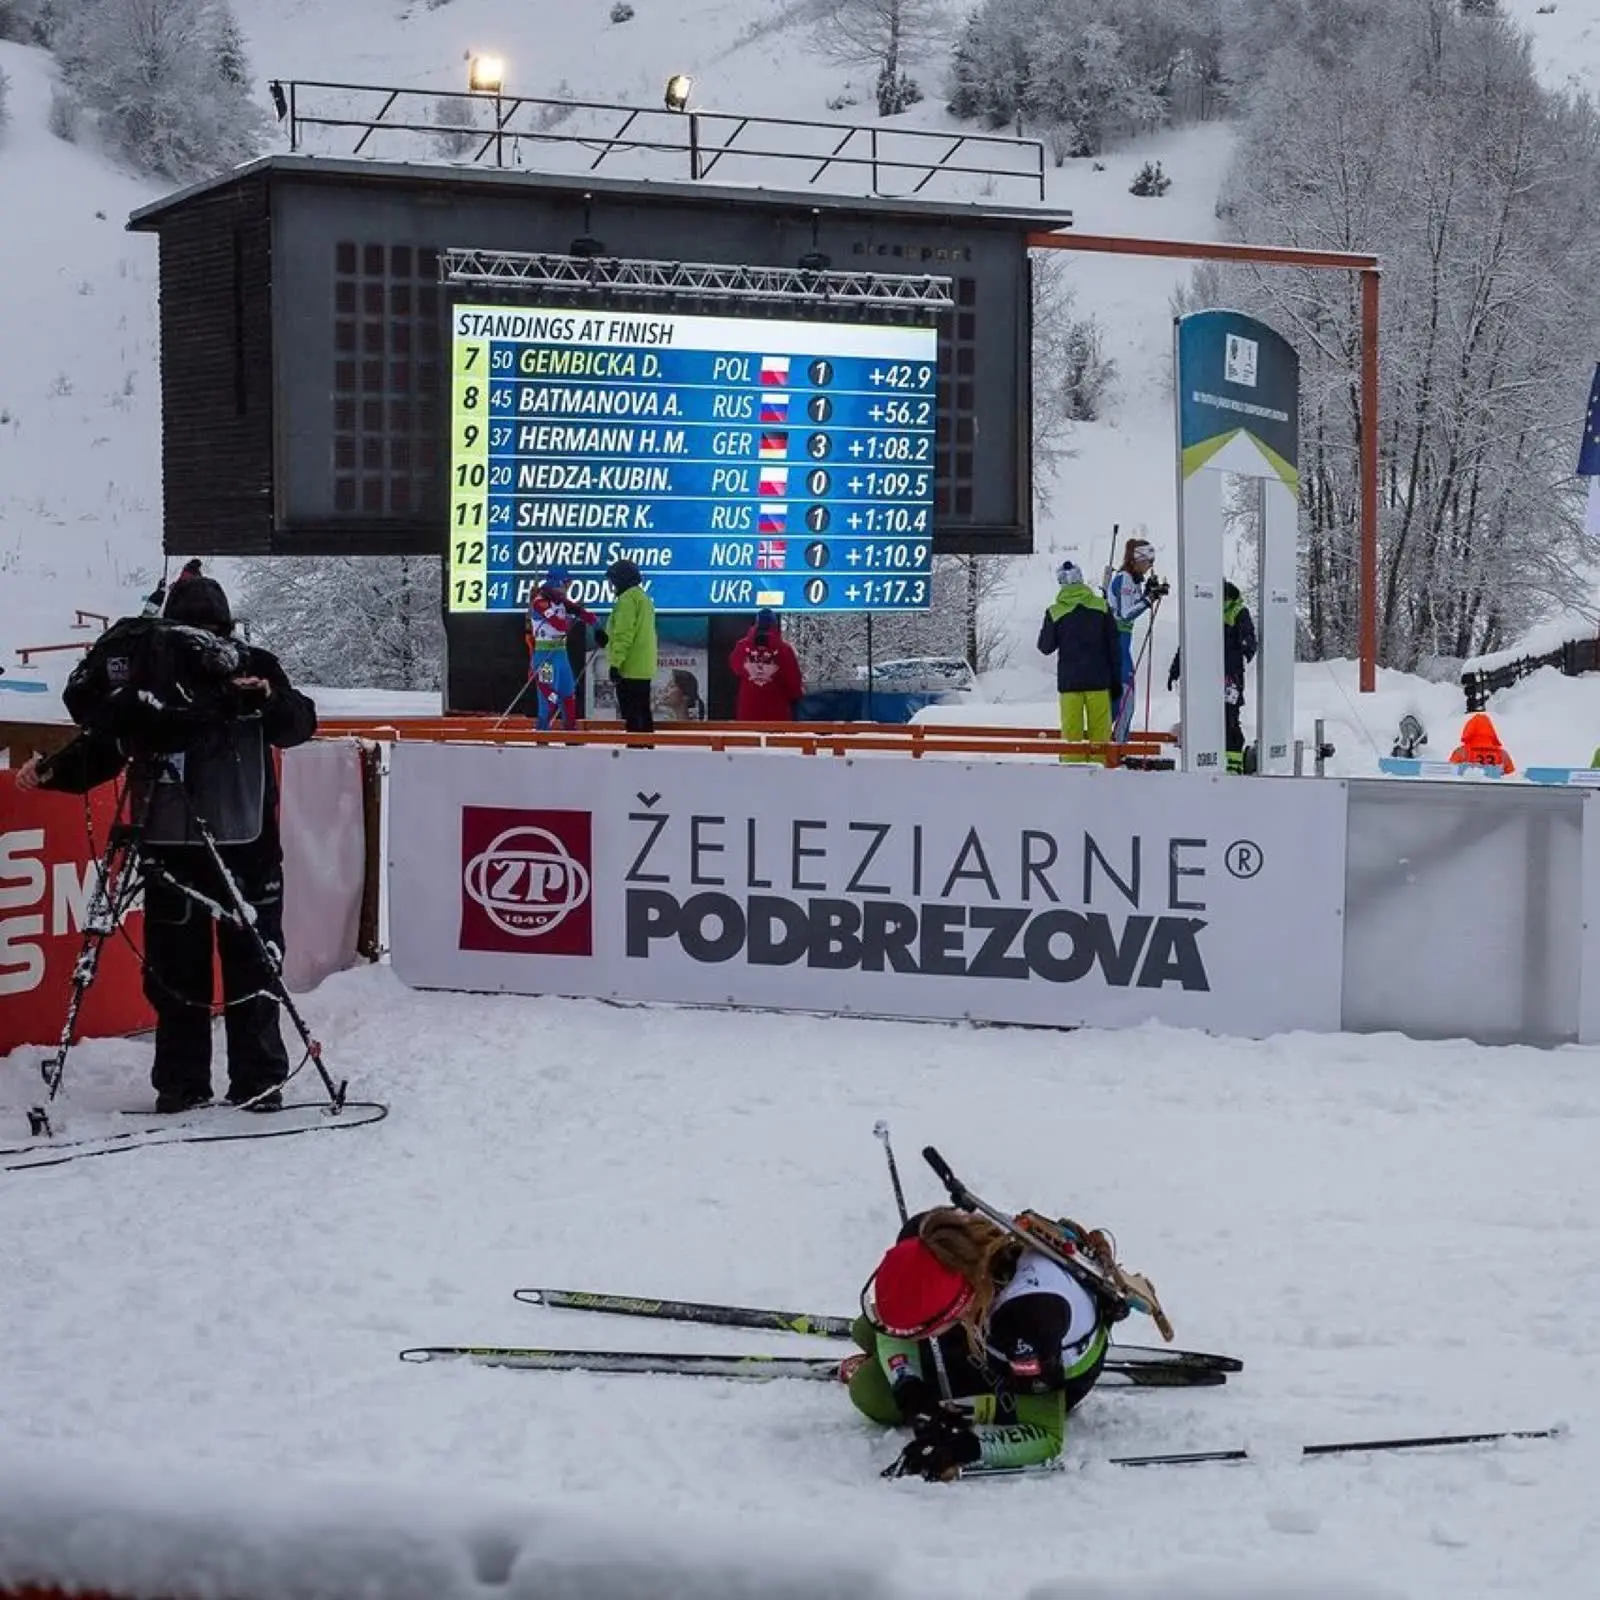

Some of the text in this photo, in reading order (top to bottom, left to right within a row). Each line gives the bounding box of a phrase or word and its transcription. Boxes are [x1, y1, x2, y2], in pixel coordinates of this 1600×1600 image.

[458, 313, 675, 344] STANDINGS AT FINISH
[465, 347, 931, 388] 7 50 GEMBICKA D. POL 1 +42.9
[463, 387, 930, 425] 8 45 BATMANOVA A. RUS 1 +56.2
[464, 425, 929, 460] 9 37 HERMANN H.M. GER 3 +1:08.2
[456, 464, 928, 496] 10 20 NEDZA-KUBIN. POL 0 +1:09.5
[456, 502, 926, 531] 11 24 SHNEIDER K. RUS 1 +1:10.4
[455, 541, 926, 568] 12 16 OWREN Synne NOR 1 +1:10.9
[455, 580, 483, 603] 13
[488, 581, 508, 599] 41
[710, 580, 752, 603] UKR
[810, 580, 824, 604] 0
[845, 580, 925, 604] +1:17.3
[624, 791, 1208, 911] ŽELEZIARNE
[502, 915, 547, 924] 1840
